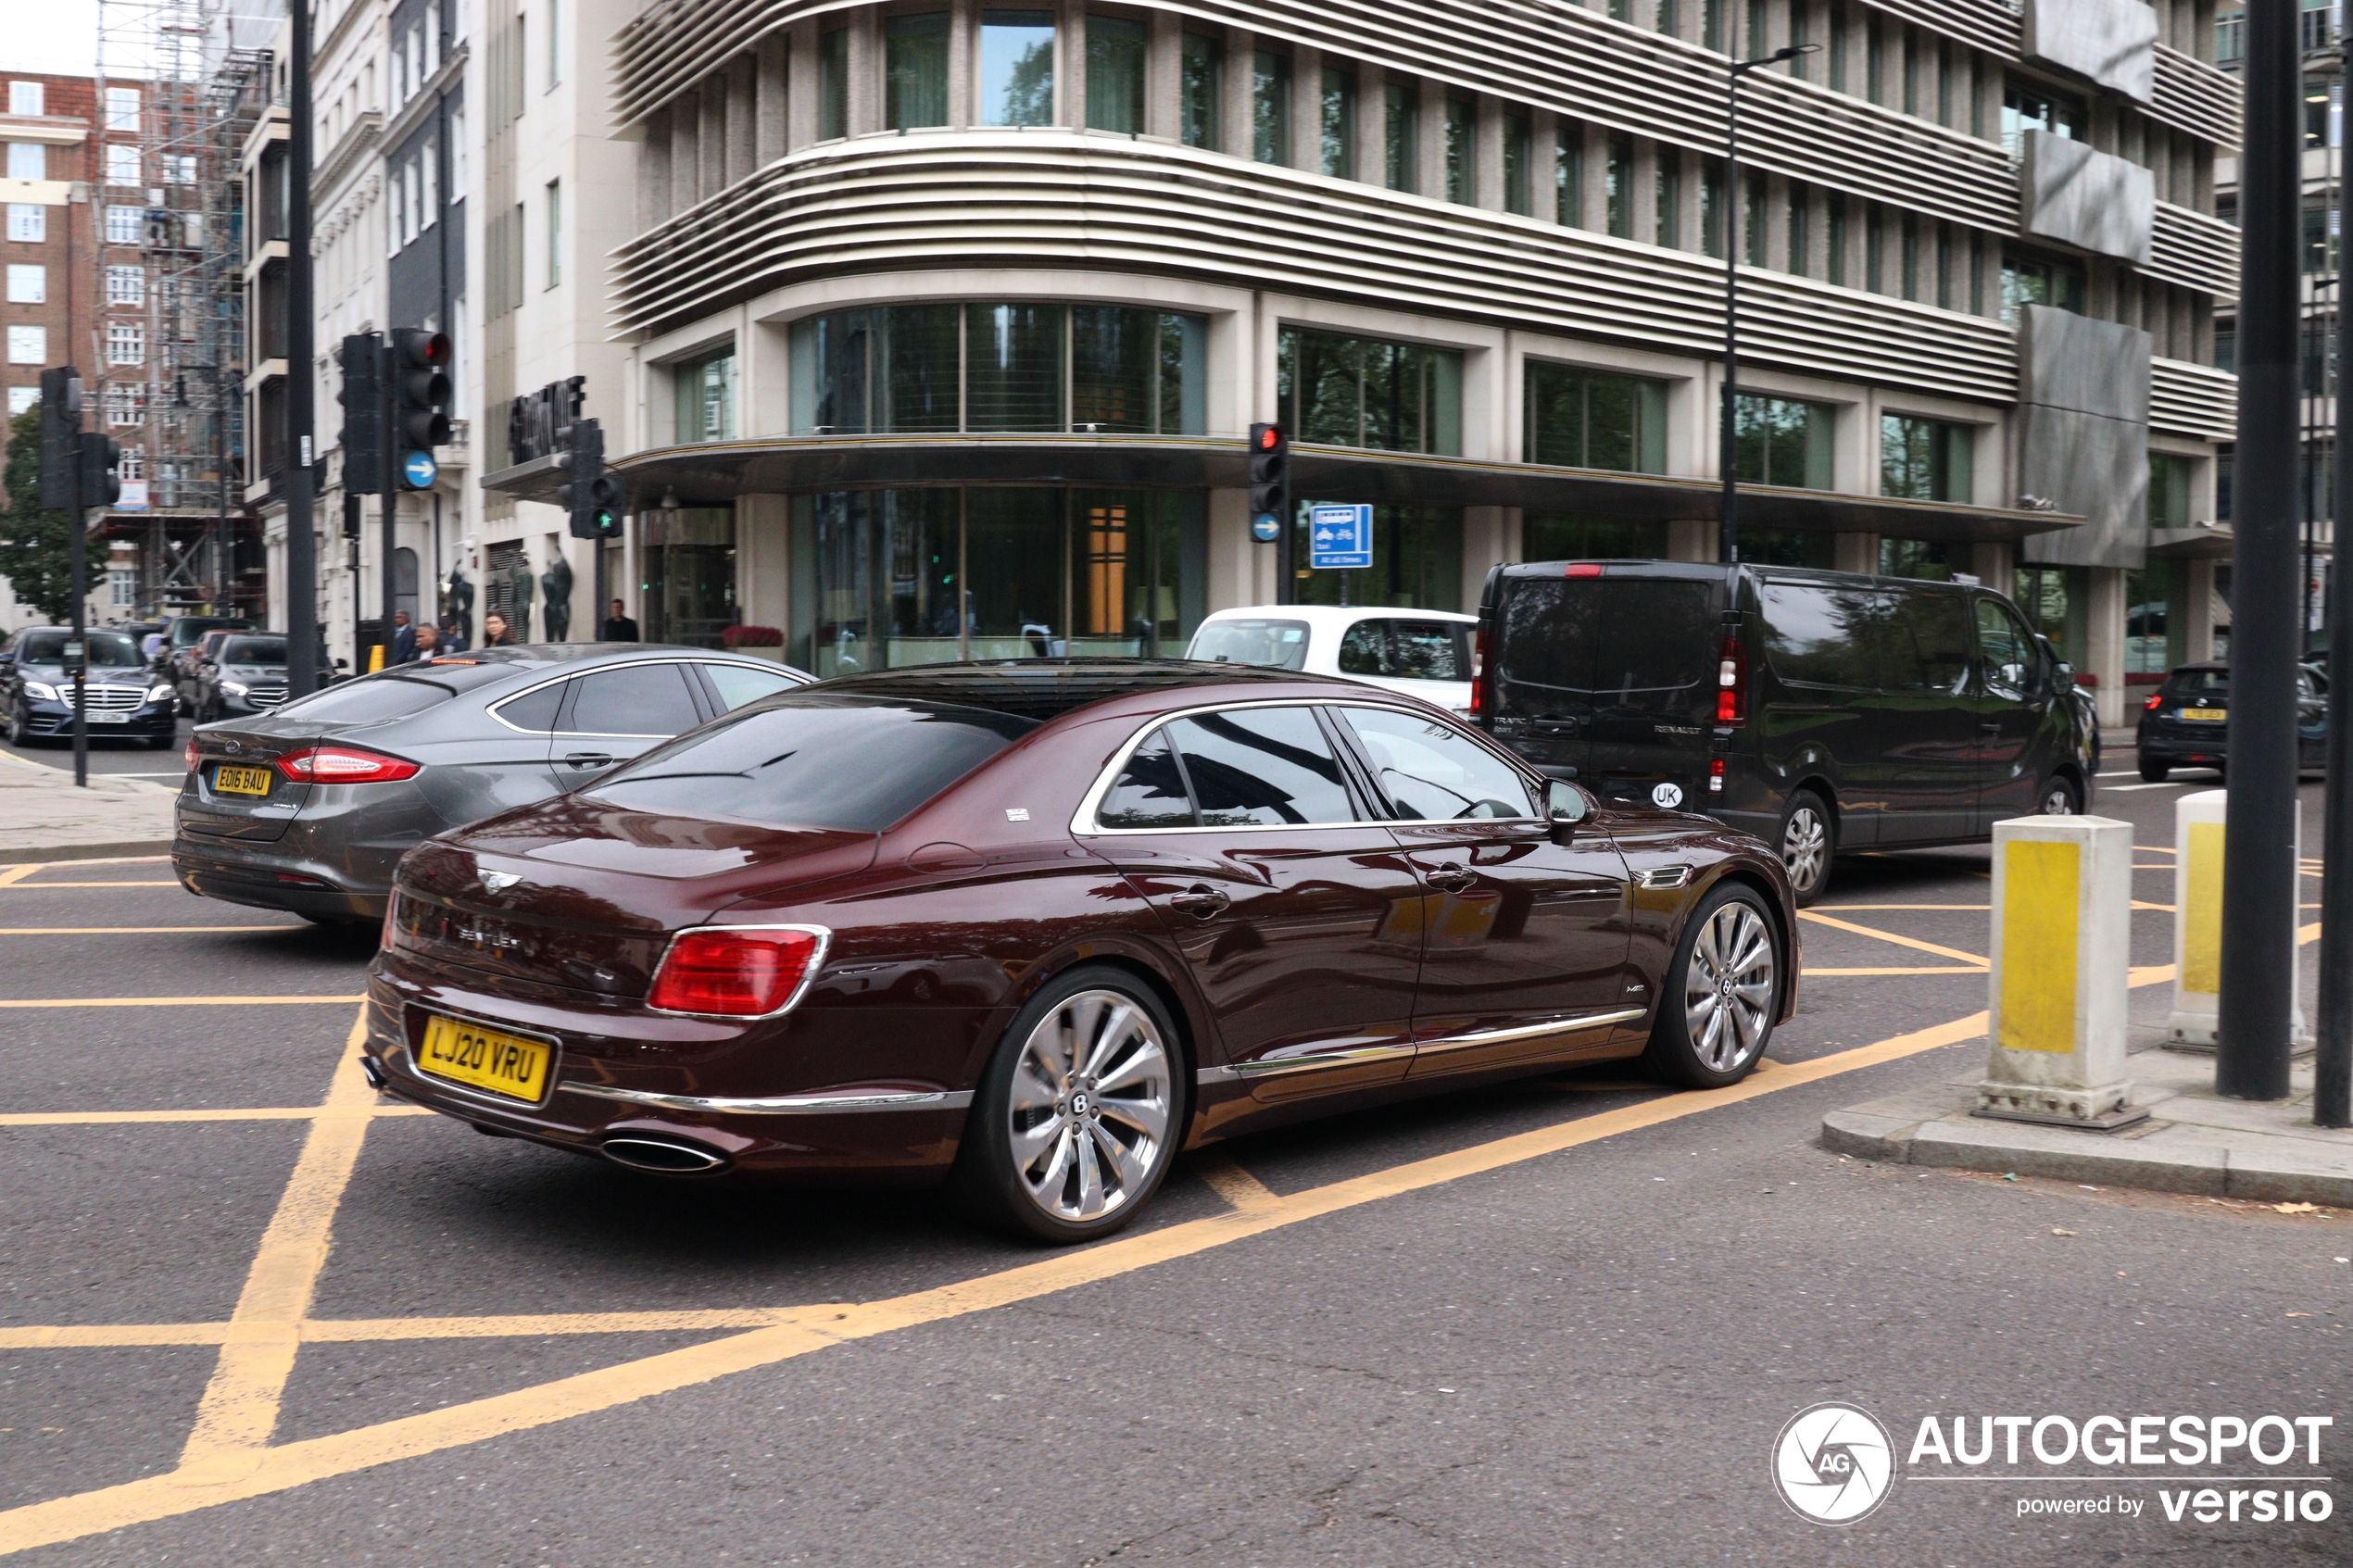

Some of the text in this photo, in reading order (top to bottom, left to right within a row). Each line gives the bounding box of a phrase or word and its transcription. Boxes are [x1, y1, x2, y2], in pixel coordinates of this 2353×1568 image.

[1493, 717, 1527, 725] TRAFIC
[1654, 725, 1702, 734] RENAULT
[220, 770, 266, 790] EO16 BAU
[1657, 787, 1678, 804] UK
[432, 1026, 535, 1083] LJ20 VRU
